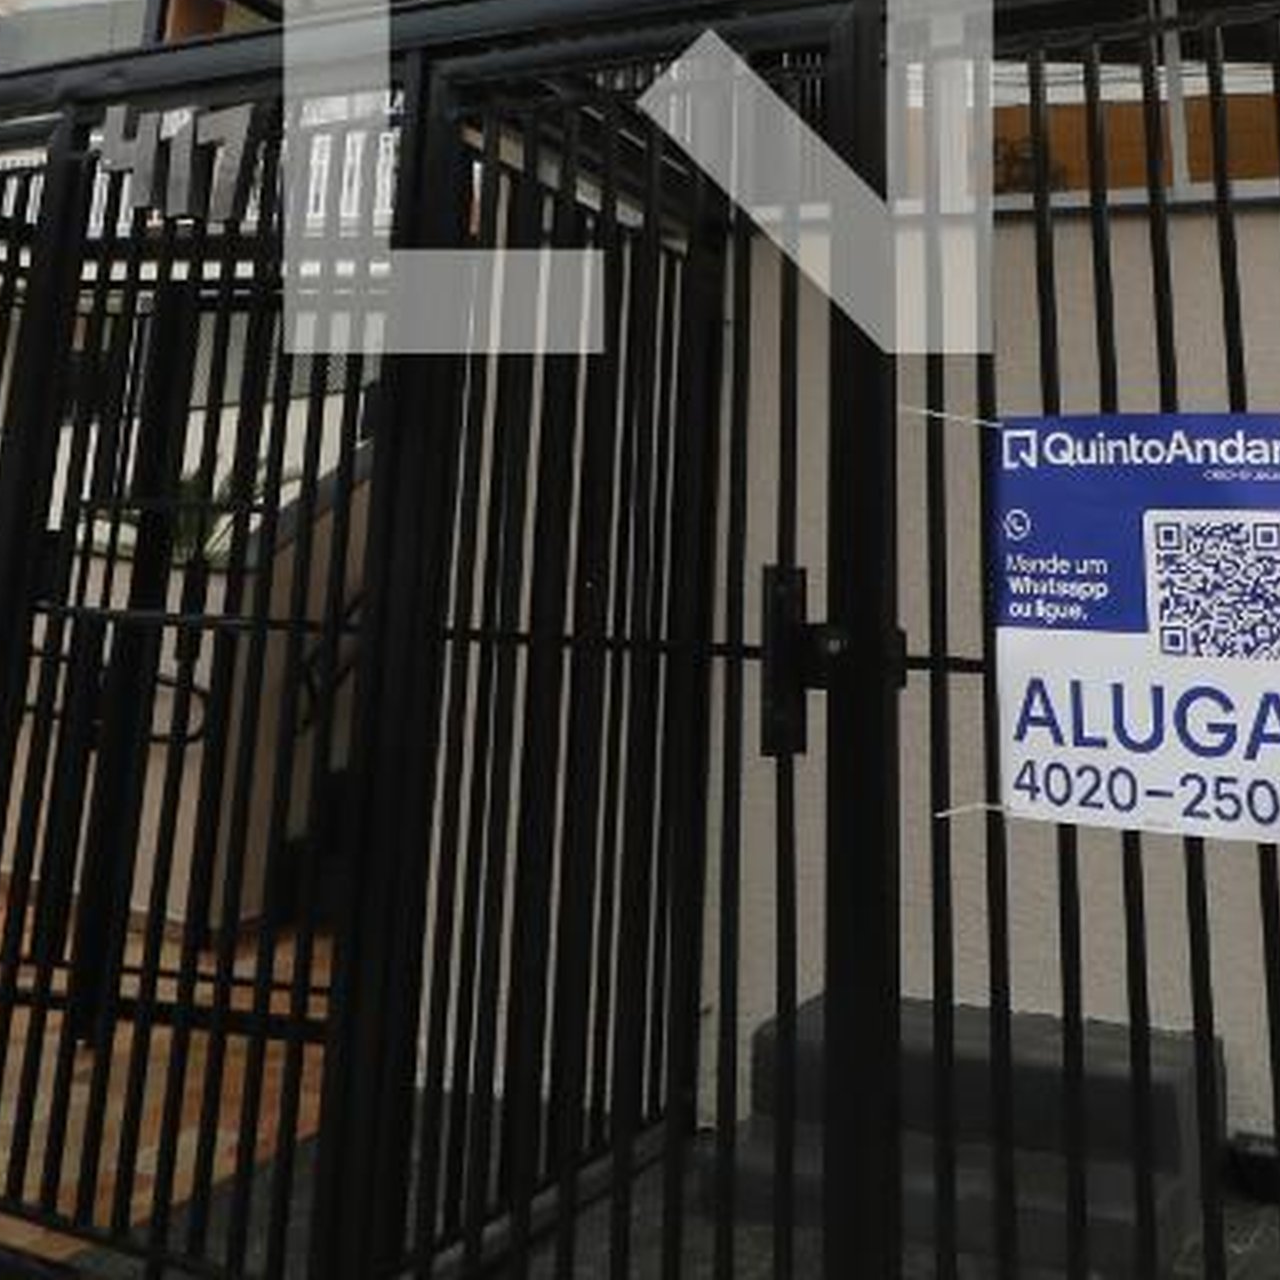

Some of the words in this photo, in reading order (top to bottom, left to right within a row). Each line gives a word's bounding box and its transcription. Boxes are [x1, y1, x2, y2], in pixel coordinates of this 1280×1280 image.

[1006, 553, 1070, 575] Mande
[1075, 558, 1108, 575] um
[1008, 601, 1032, 618] ou
